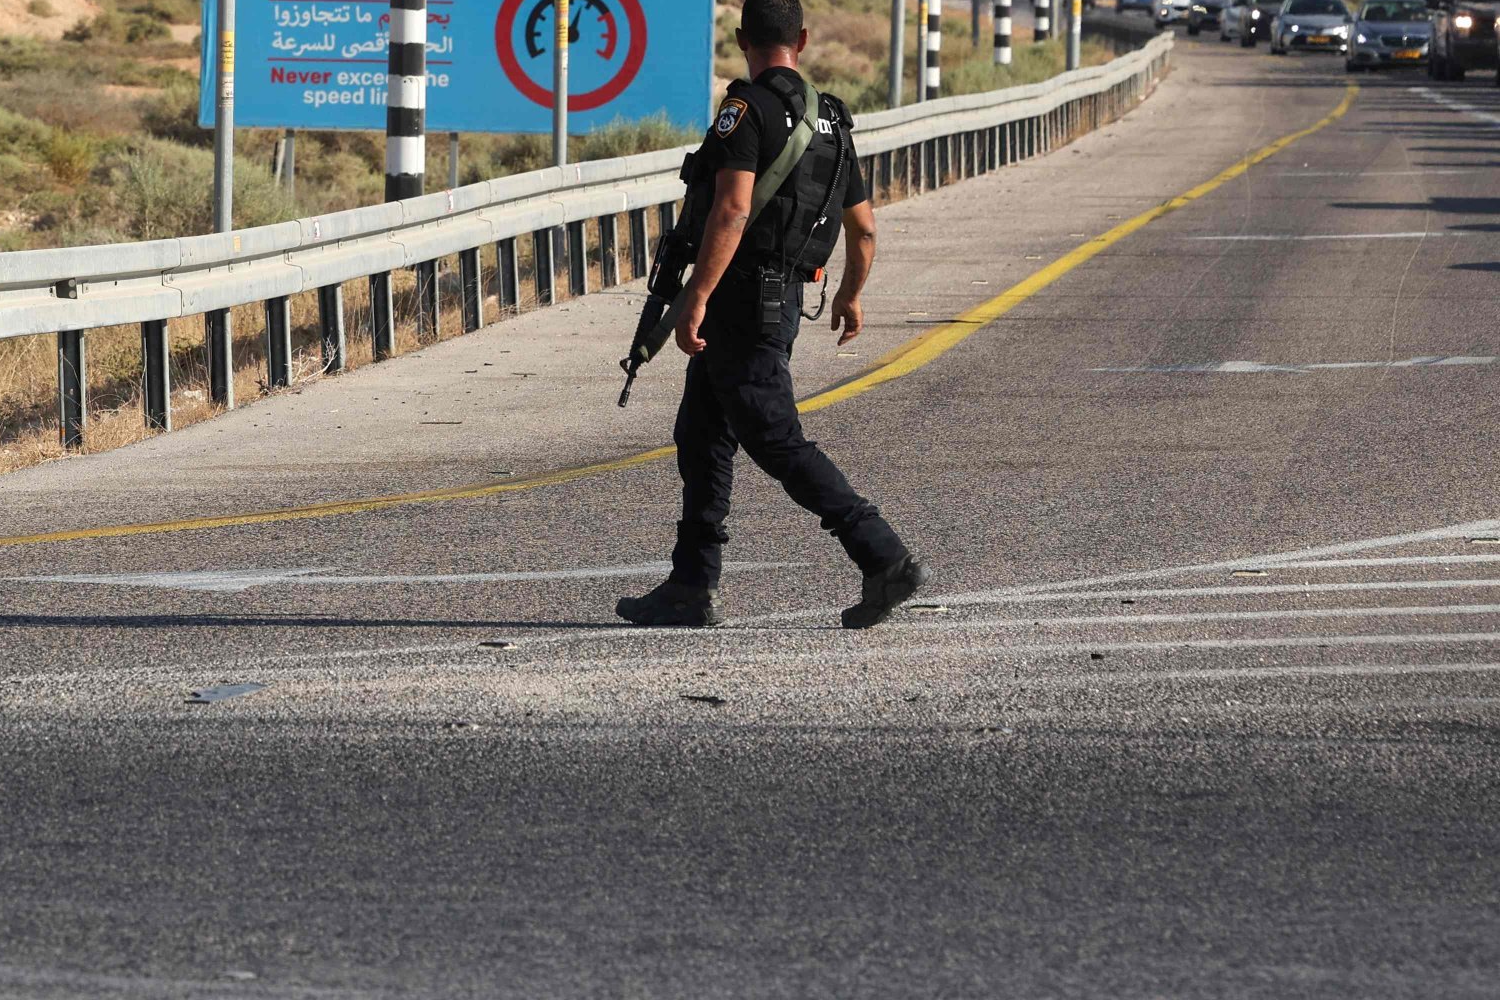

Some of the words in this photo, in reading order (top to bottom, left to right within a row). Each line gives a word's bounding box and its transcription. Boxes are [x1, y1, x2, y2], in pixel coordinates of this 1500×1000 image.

[273, 4, 350, 28] تتجاوزوا
[355, 5, 373, 23] ما
[271, 31, 336, 57] للسرعة
[425, 35, 453, 54] الح
[270, 66, 332, 85] Never
[336, 70, 388, 87] exce
[425, 69, 450, 87] he
[303, 86, 366, 109] speed
